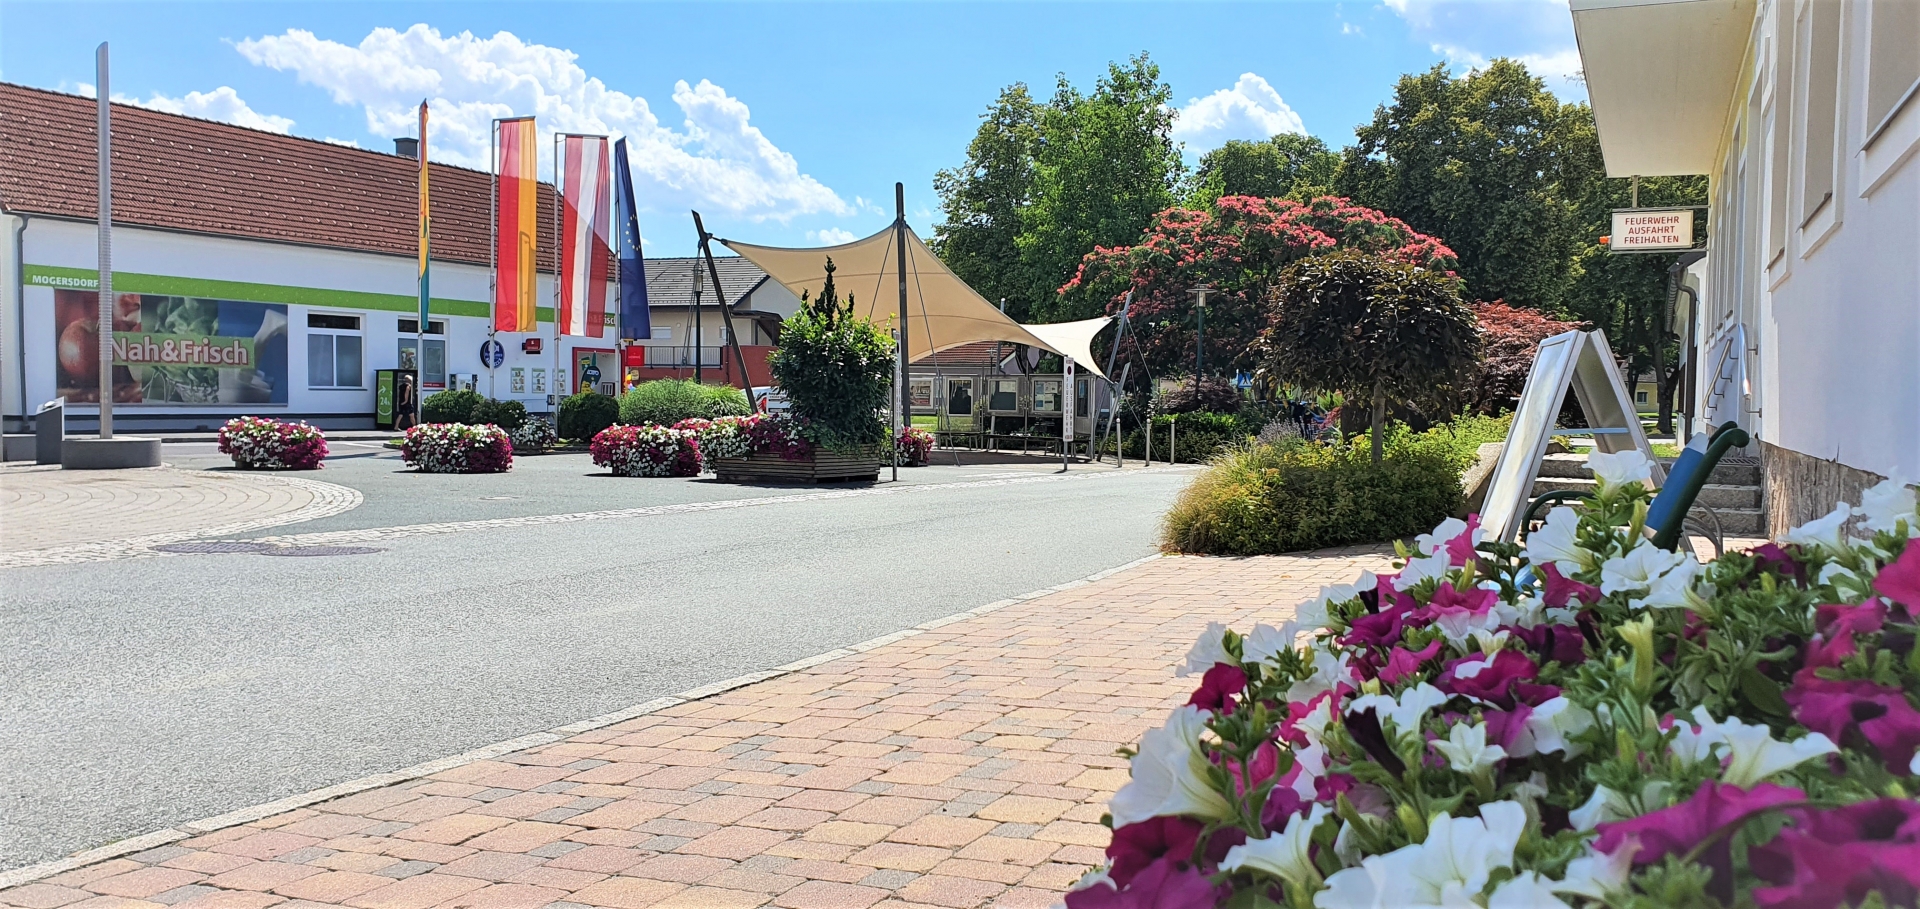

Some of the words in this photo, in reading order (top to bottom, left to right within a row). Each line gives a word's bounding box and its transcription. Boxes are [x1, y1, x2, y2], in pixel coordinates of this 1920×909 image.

[1625, 216, 1680, 225] FEUERWEHR
[1628, 226, 1675, 235] AUSFAHRT
[1624, 235, 1679, 244] FREIHALTEN
[32, 274, 99, 287] MOGERSDORF
[112, 335, 249, 365] Nah&Frisch
